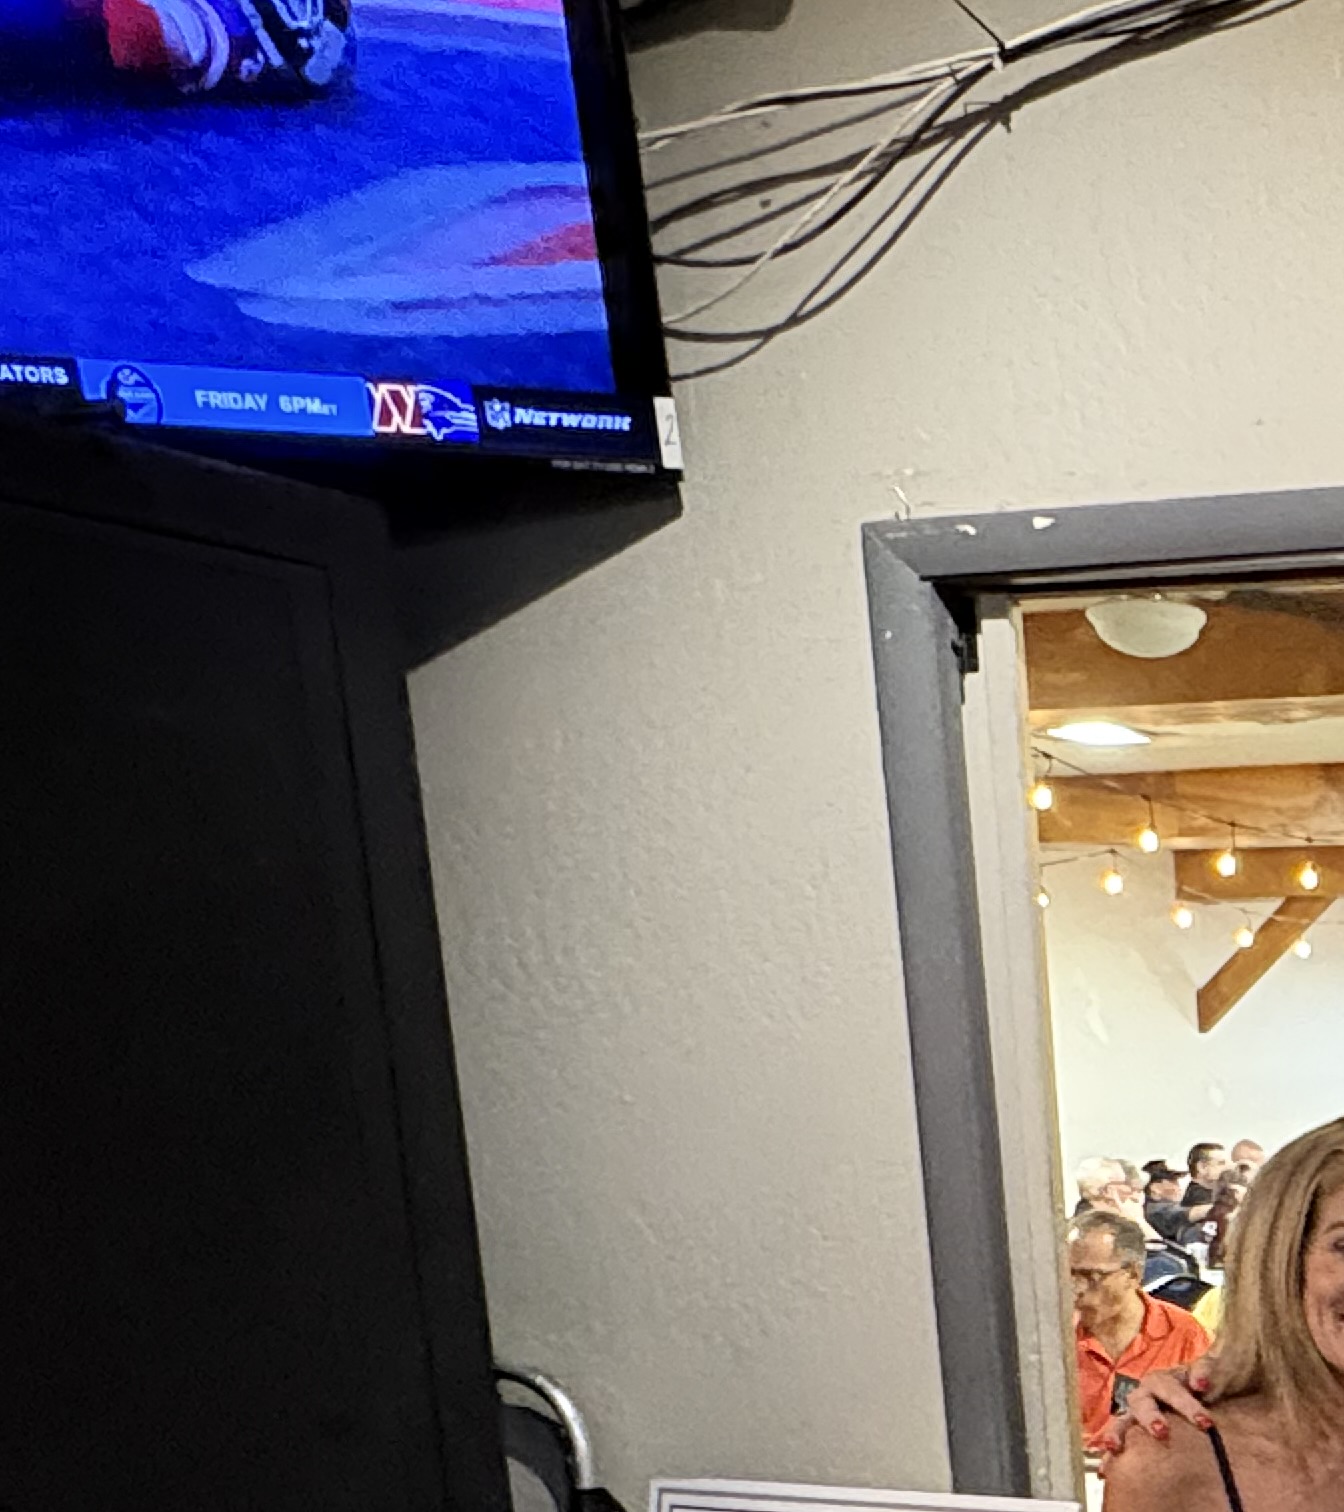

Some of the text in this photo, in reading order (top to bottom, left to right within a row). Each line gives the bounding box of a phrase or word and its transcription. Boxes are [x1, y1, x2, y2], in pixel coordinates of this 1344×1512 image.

[194, 387, 268, 412] FRIDAY
[513, 406, 632, 433] NETWORK
[663, 414, 677, 446] 2
